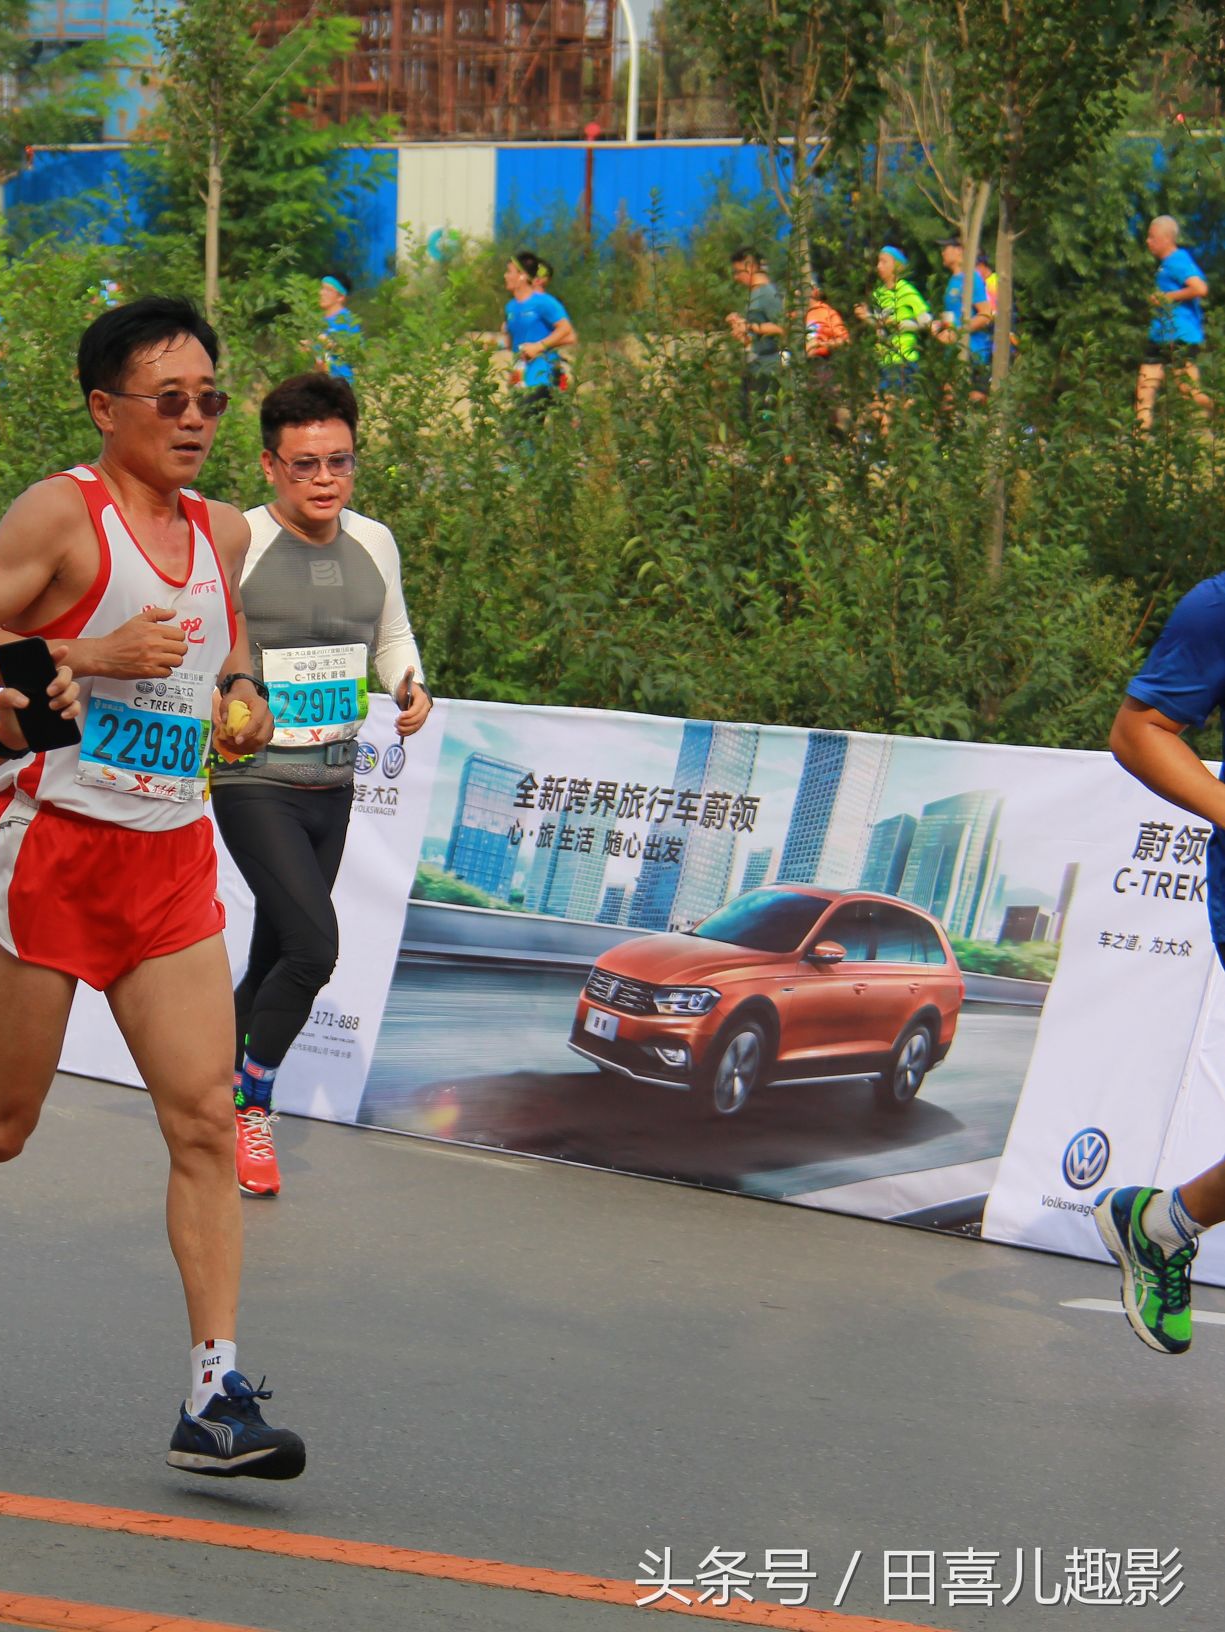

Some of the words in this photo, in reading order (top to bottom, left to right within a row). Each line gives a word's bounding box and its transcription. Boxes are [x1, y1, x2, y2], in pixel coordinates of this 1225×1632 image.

[294, 671, 327, 682] C-TREK
[133, 696, 175, 713] C-TREK
[276, 686, 352, 723] 22975
[92, 713, 197, 773] 22938
[513, 772, 761, 833] 全新跨界旅行车蔚领
[602, 829, 684, 864] 随心出发
[1132, 821, 1211, 866] 蔚领
[1113, 867, 1207, 902] C-TREK
[1041, 1194, 1096, 1217] Volkswage
